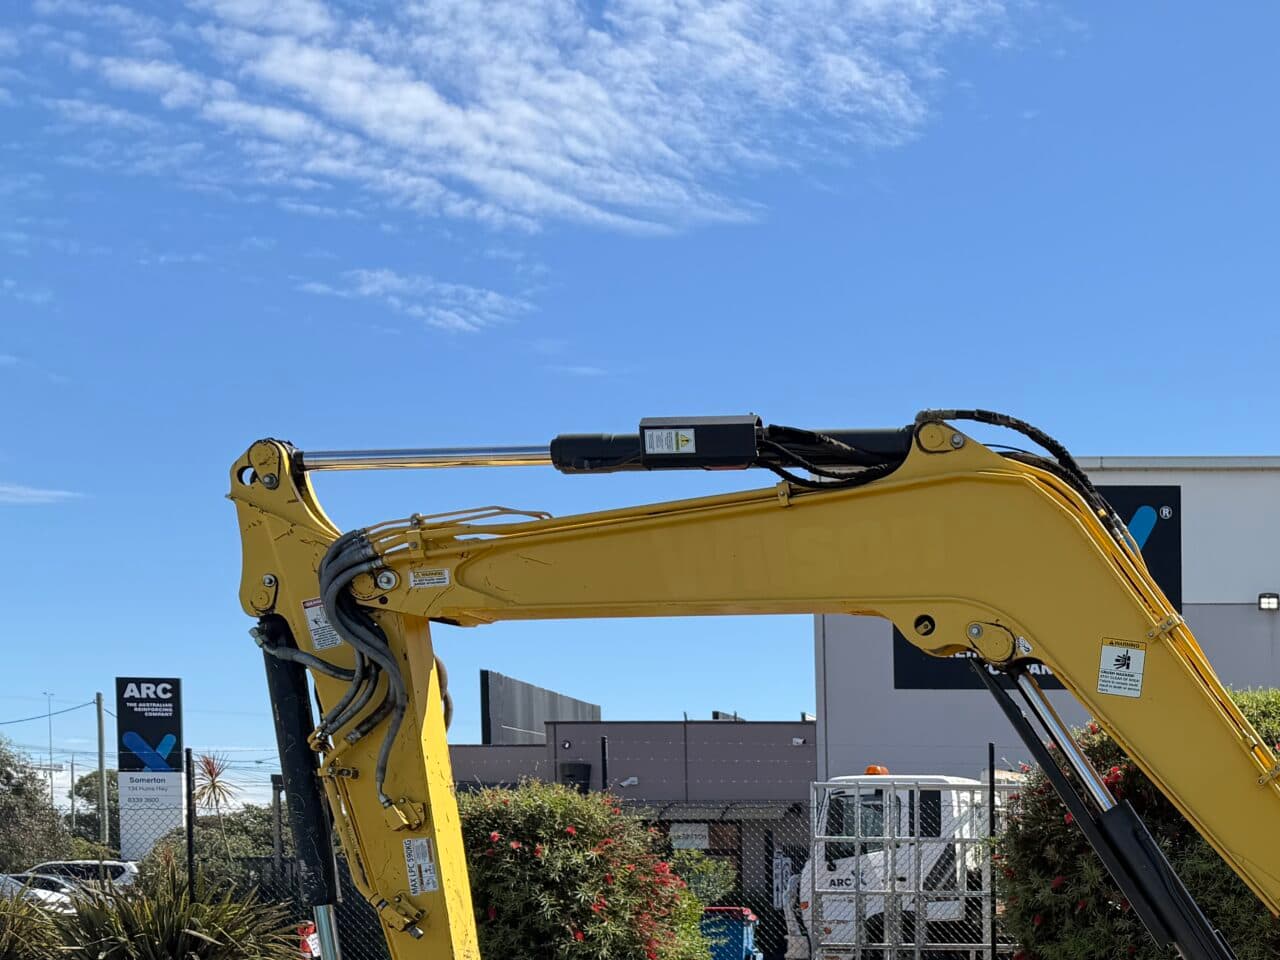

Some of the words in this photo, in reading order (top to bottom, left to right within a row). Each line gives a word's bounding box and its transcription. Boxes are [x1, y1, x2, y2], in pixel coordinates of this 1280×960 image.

[1115, 640, 1140, 649] WARNING
[123, 682, 173, 699] ARC
[129, 776, 166, 784] Somerton
[409, 879, 418, 895] MAX
[829, 878, 852, 887] ARC
